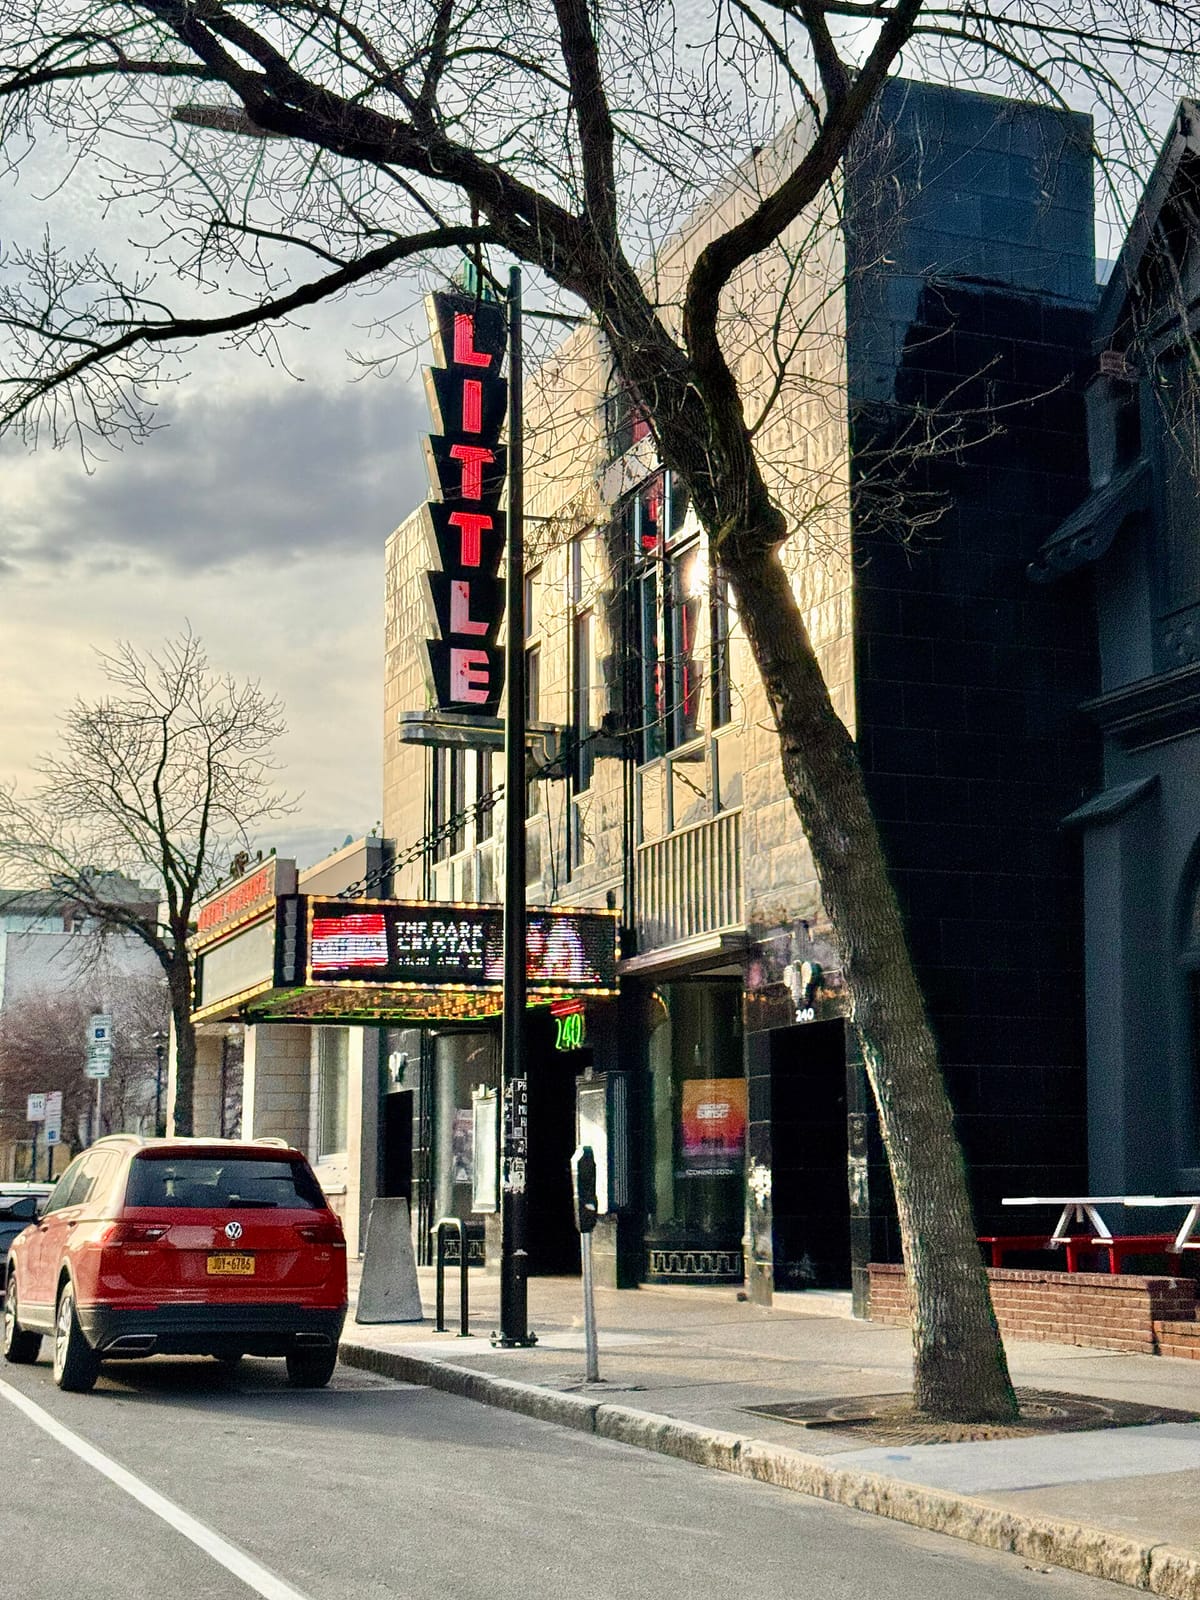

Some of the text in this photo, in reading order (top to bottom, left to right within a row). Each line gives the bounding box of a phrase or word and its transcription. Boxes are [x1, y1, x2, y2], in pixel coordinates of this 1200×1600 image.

[448, 311, 496, 704] LITTLE
[432, 921, 484, 938] DARK
[398, 937, 483, 953] CRYSTAL
[795, 1007, 814, 1022] 240
[555, 1013, 581, 1049] 240
